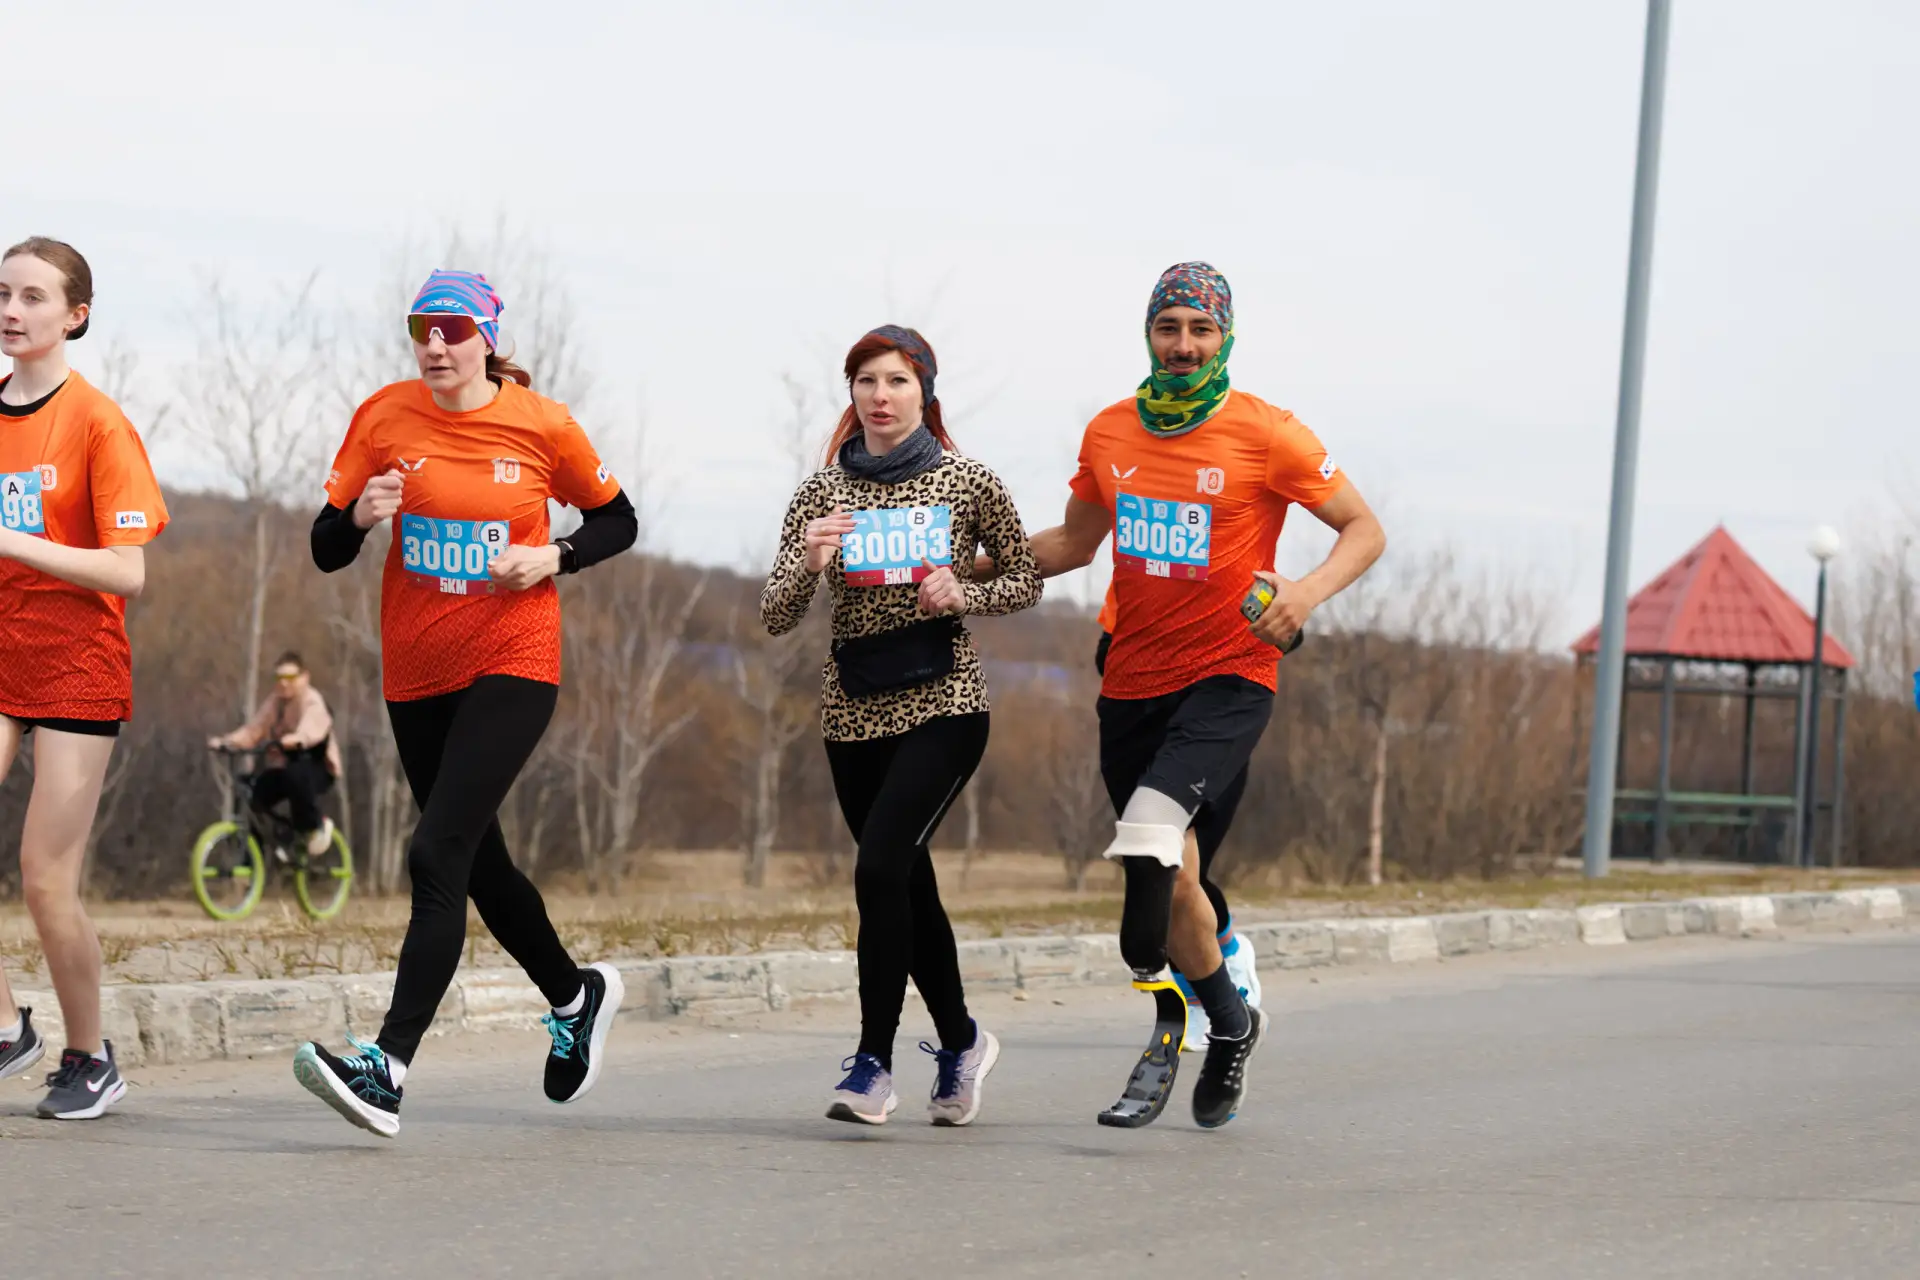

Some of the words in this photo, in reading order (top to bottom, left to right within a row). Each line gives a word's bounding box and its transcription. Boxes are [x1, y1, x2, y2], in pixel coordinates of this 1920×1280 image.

[491, 458, 520, 484] 10
[8, 482, 19, 495] A
[1196, 468, 1224, 495] 10
[914, 512, 925, 525] B
[1188, 511, 1199, 525] B
[488, 529, 500, 542] B
[1119, 516, 1206, 559] 30062
[845, 528, 947, 565] 30063
[884, 567, 912, 585] 5KM
[1145, 559, 1171, 577] 5KM
[440, 577, 467, 595] 5KM
